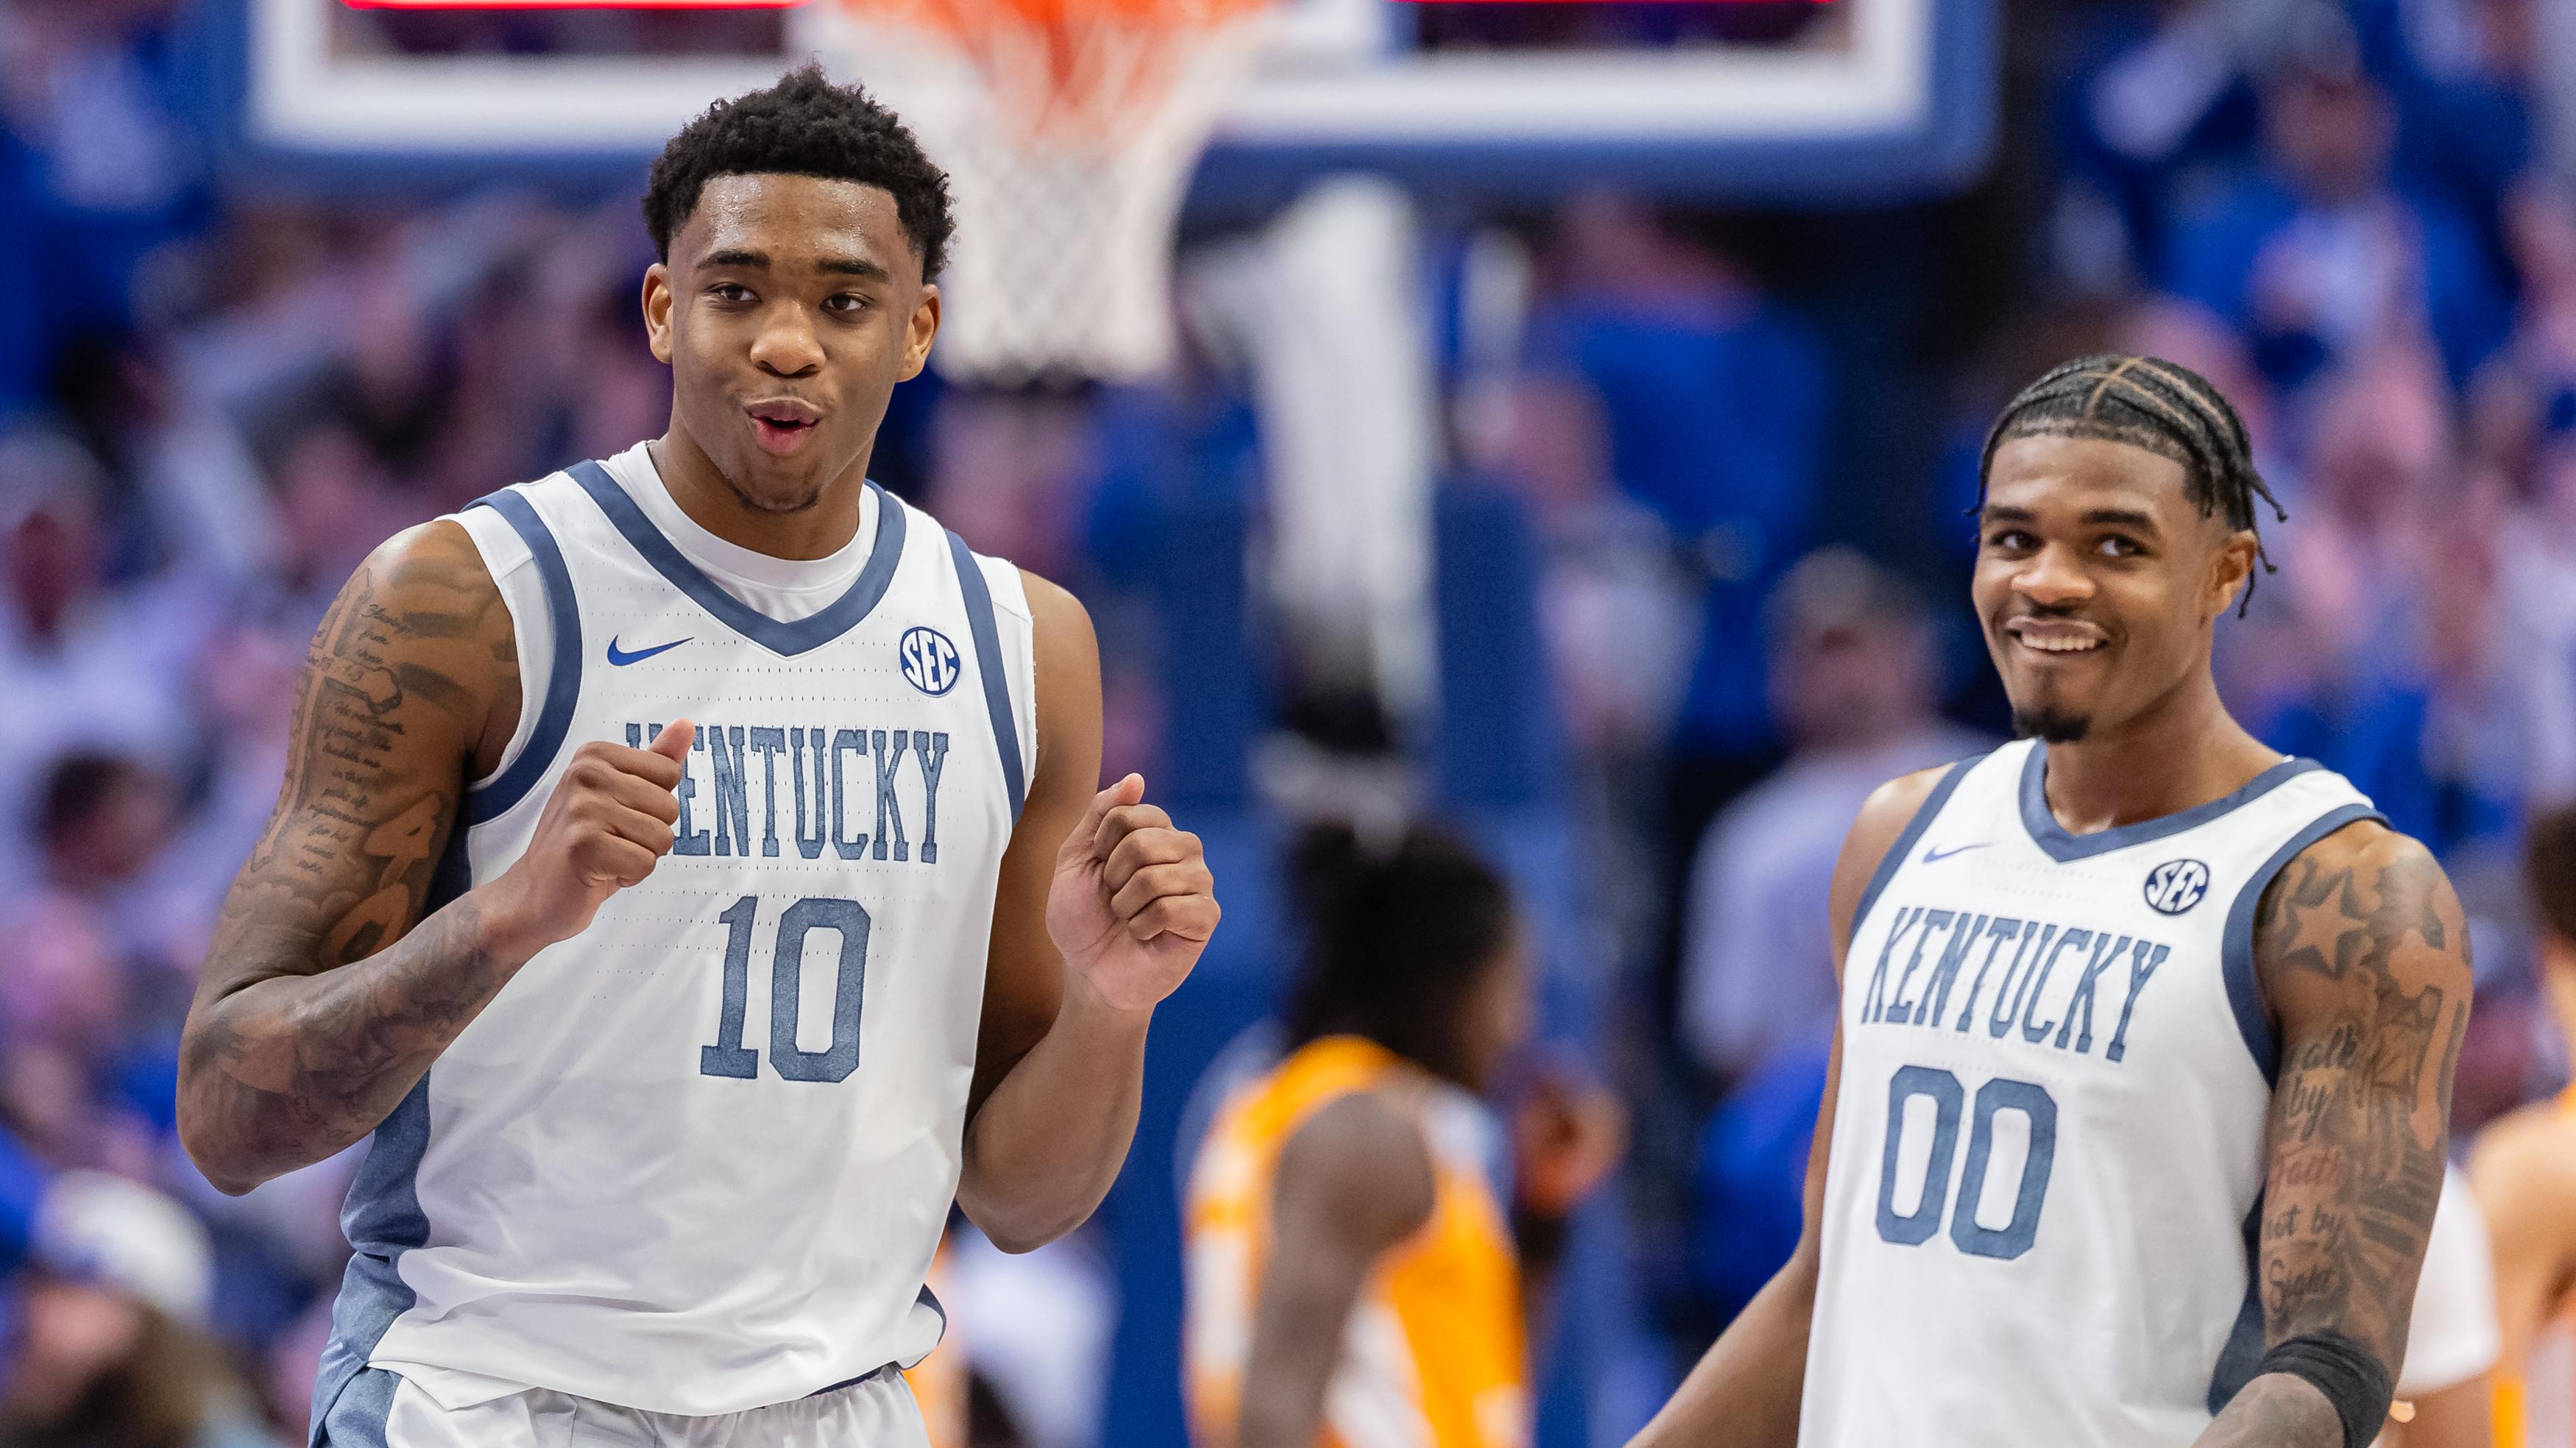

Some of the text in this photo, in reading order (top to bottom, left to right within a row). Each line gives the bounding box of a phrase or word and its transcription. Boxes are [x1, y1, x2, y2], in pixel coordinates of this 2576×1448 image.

[902, 629, 958, 692] SEC
[2146, 860, 2207, 913] SEC
[701, 896, 871, 1083] 10
[1861, 906, 2170, 1063] KENTUCKY
[1875, 1065, 2057, 1261] 00
